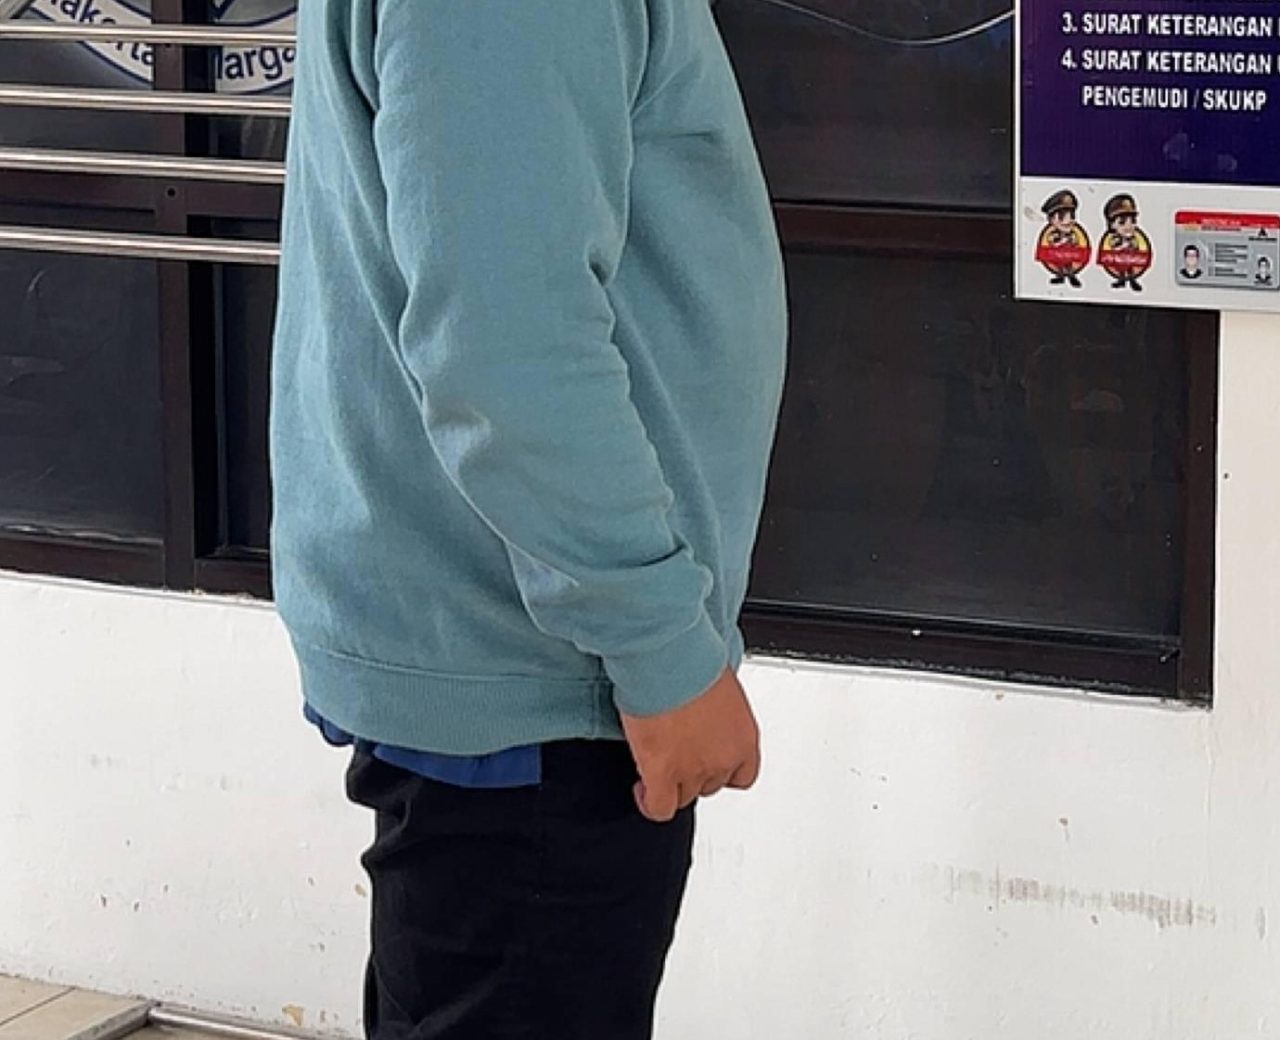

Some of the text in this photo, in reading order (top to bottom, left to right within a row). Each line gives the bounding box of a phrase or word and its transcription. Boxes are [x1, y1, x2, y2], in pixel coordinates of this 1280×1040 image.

[1062, 11, 1078, 33] 3.
[1083, 12, 1142, 34] SURAT
[1147, 14, 1273, 37] KETERANGAN
[215, 46, 296, 81] arga
[1083, 85, 1188, 108] PENGEMUDI
[1203, 88, 1266, 111] SKUKP
